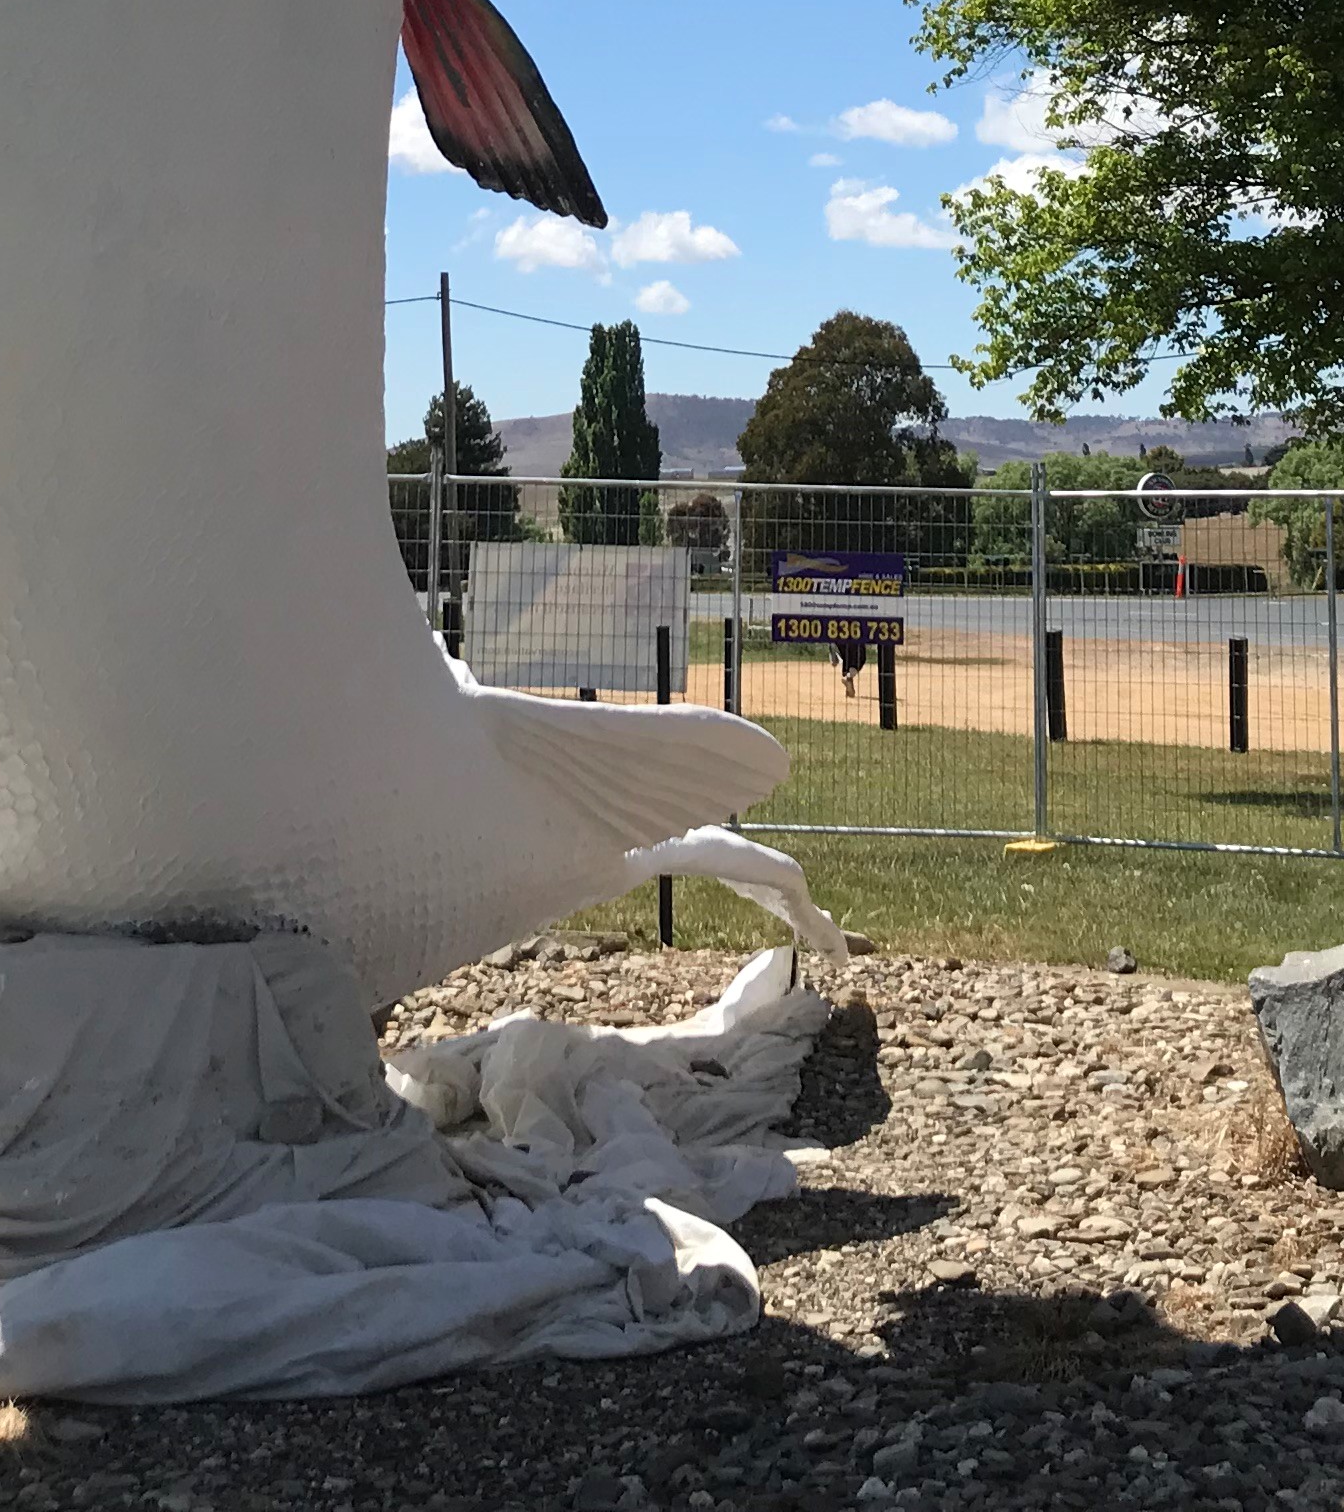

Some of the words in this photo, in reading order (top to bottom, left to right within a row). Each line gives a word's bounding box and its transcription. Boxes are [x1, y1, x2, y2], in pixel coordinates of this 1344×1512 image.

[777, 576, 902, 594] 1300TEMPFENCE
[777, 618, 822, 638] 1300
[827, 620, 861, 640] 836
[867, 621, 900, 641] 733
